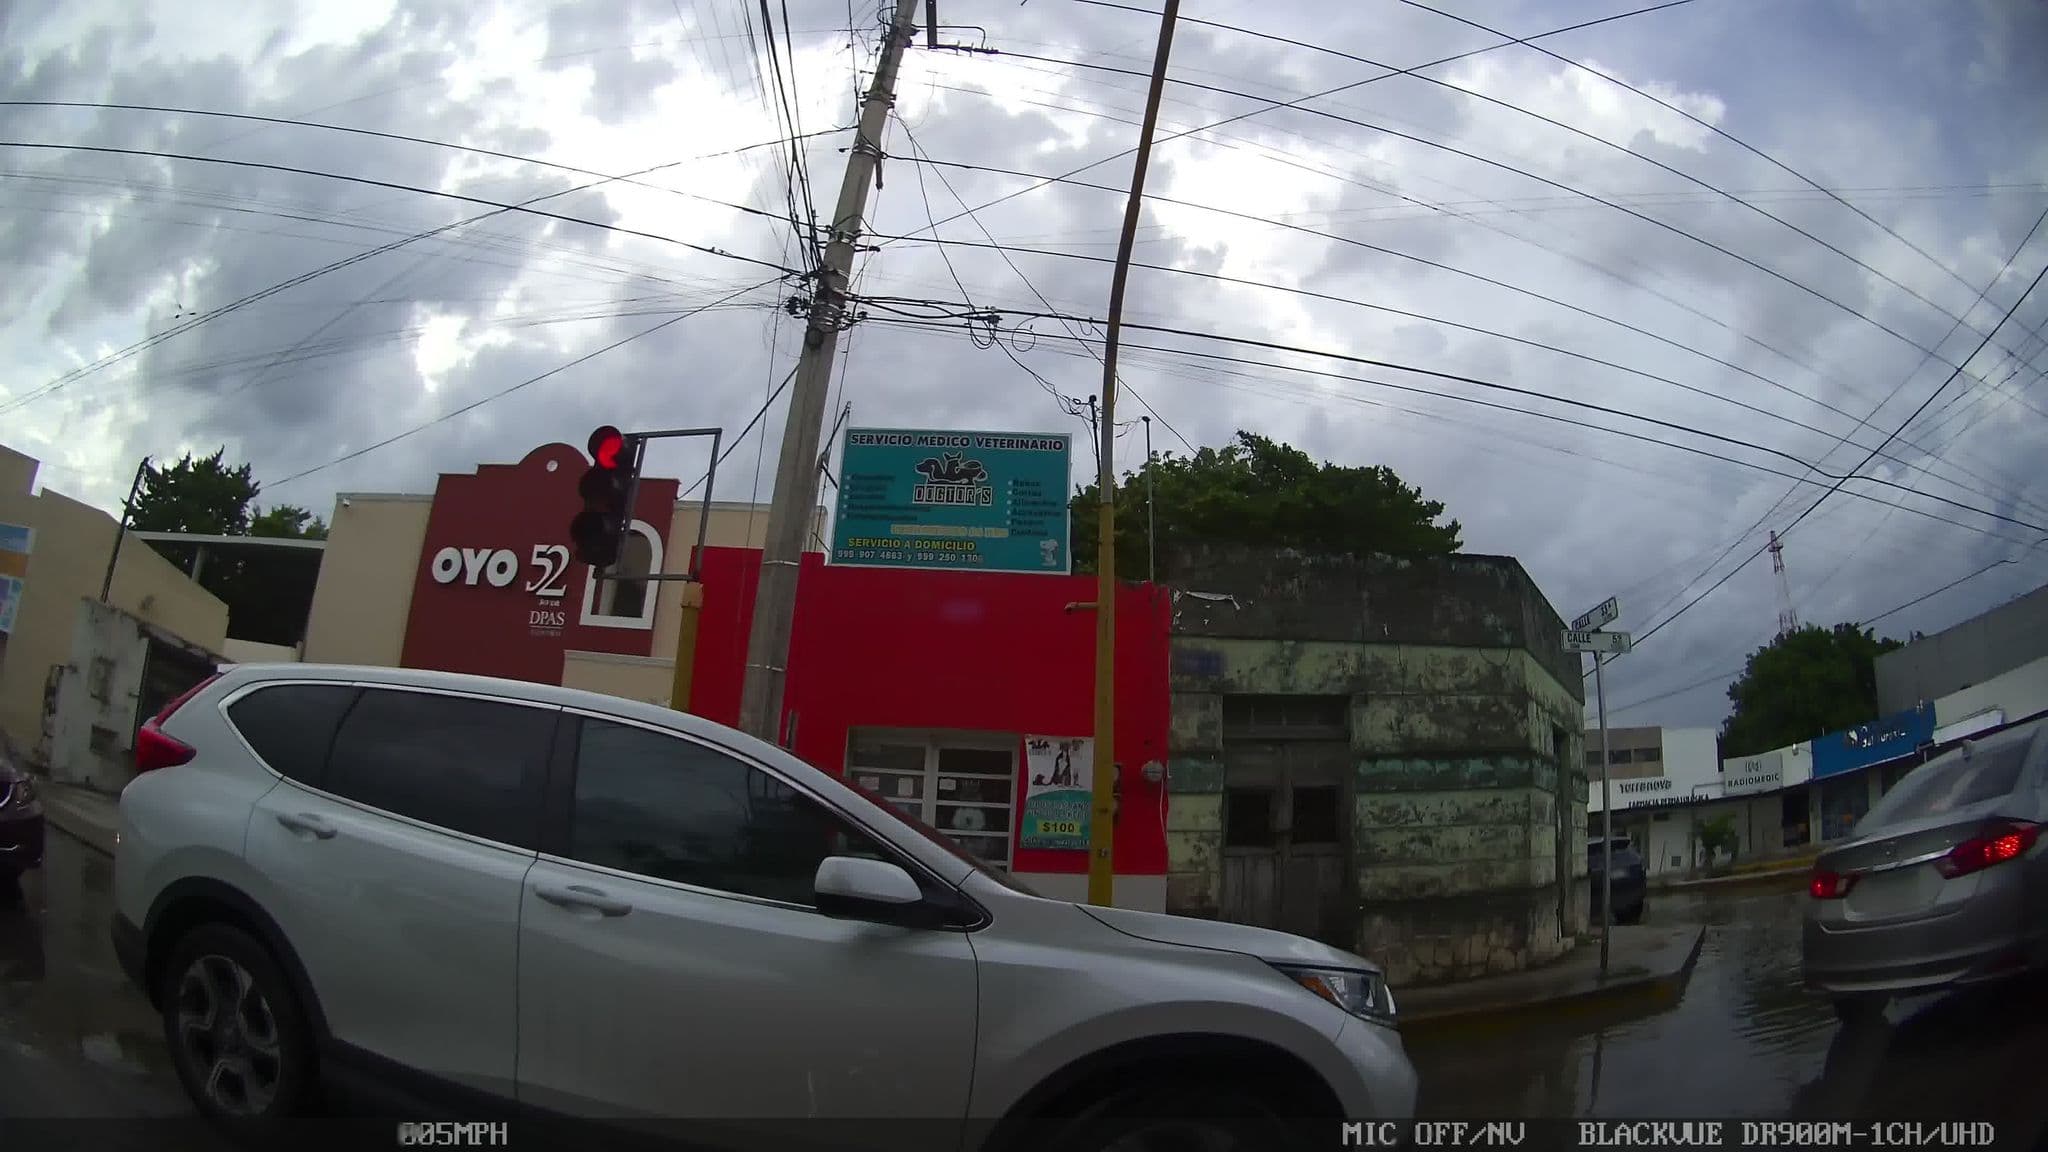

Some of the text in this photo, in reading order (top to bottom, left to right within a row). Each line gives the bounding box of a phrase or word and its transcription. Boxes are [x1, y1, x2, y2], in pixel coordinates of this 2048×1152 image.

[851, 434, 1062, 452] SERVICIO MEDICO VETERINARIO
[848, 537, 975, 551] SERVICIO A DOMICILIO
[432, 547, 518, 587] OYO
[525, 544, 570, 596] 52
[1567, 633, 1591, 643] CALLE
[1728, 773, 1779, 788] RADIOMEDIC
[1043, 822, 1075, 833] $100
